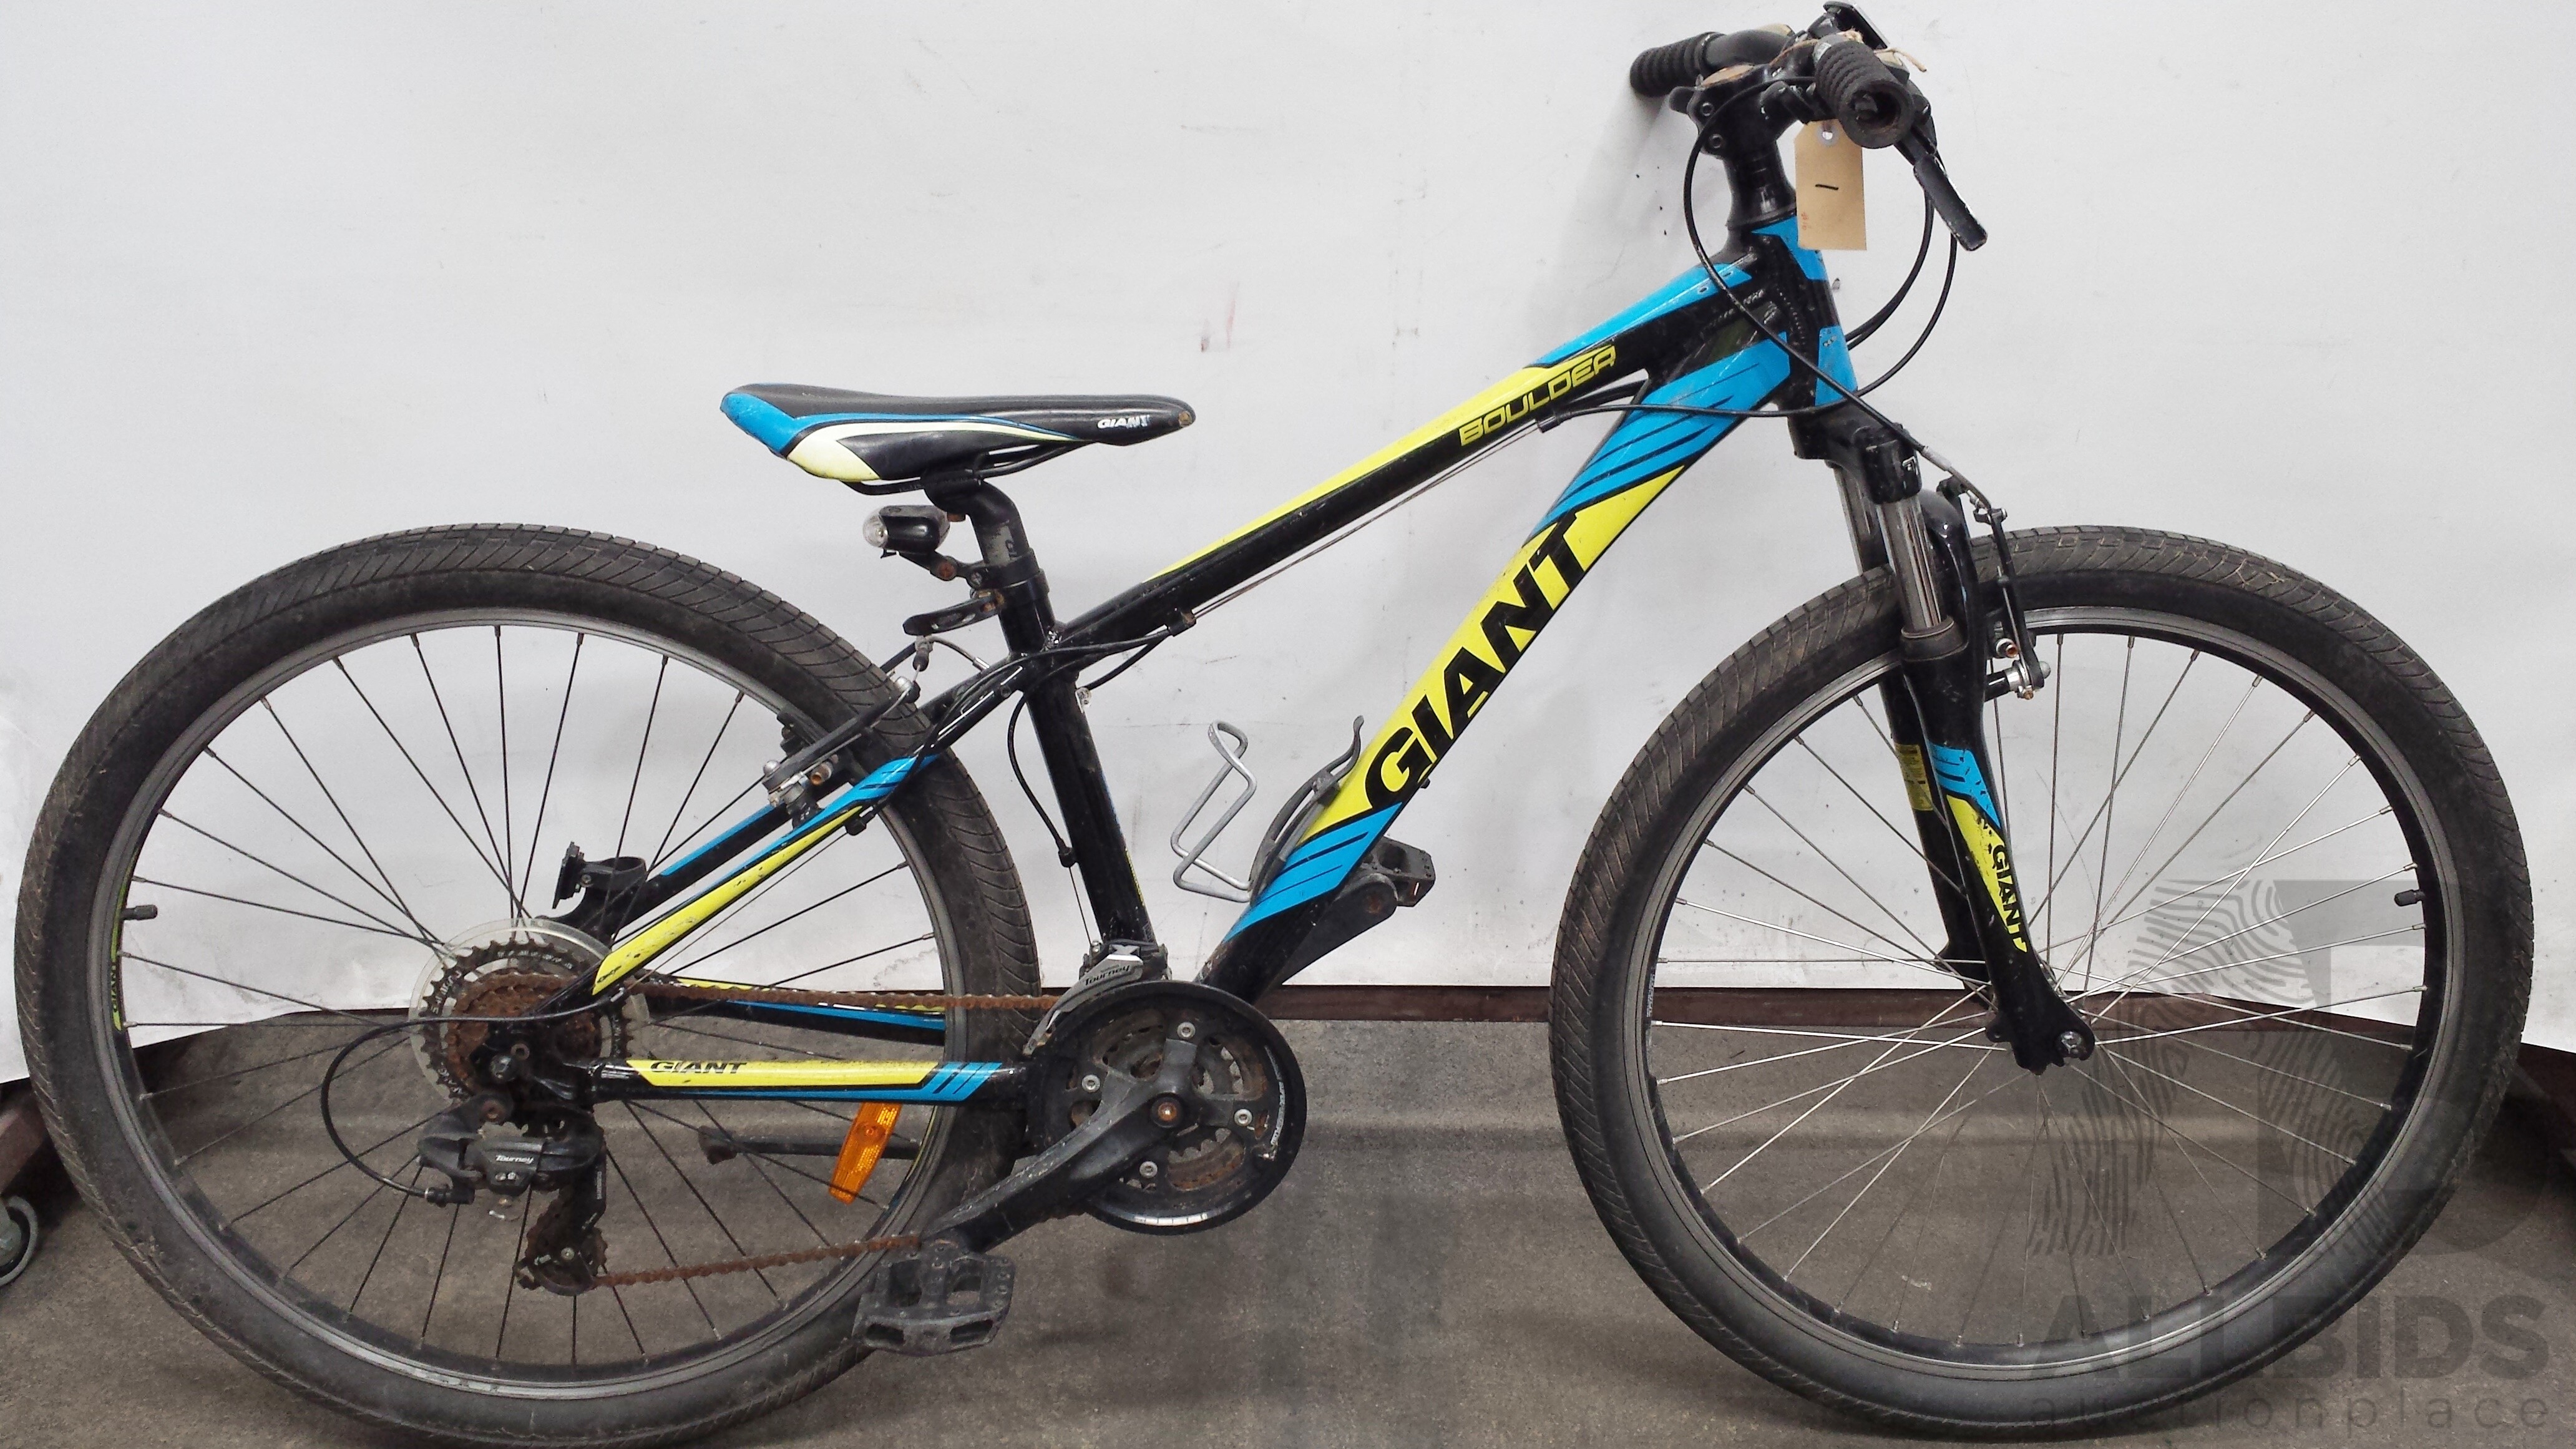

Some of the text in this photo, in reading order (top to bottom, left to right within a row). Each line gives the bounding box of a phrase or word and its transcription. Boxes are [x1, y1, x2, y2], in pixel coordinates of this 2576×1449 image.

[1460, 344, 1617, 447] BOULDER
[1097, 414, 1150, 429] GIANT
[1365, 512, 1587, 810] GIANT
[1993, 845, 2028, 950] GIANT
[1085, 965, 1129, 985] Tourney
[651, 1061, 747, 1074] GIANT
[495, 1155, 534, 1164] Tourney
